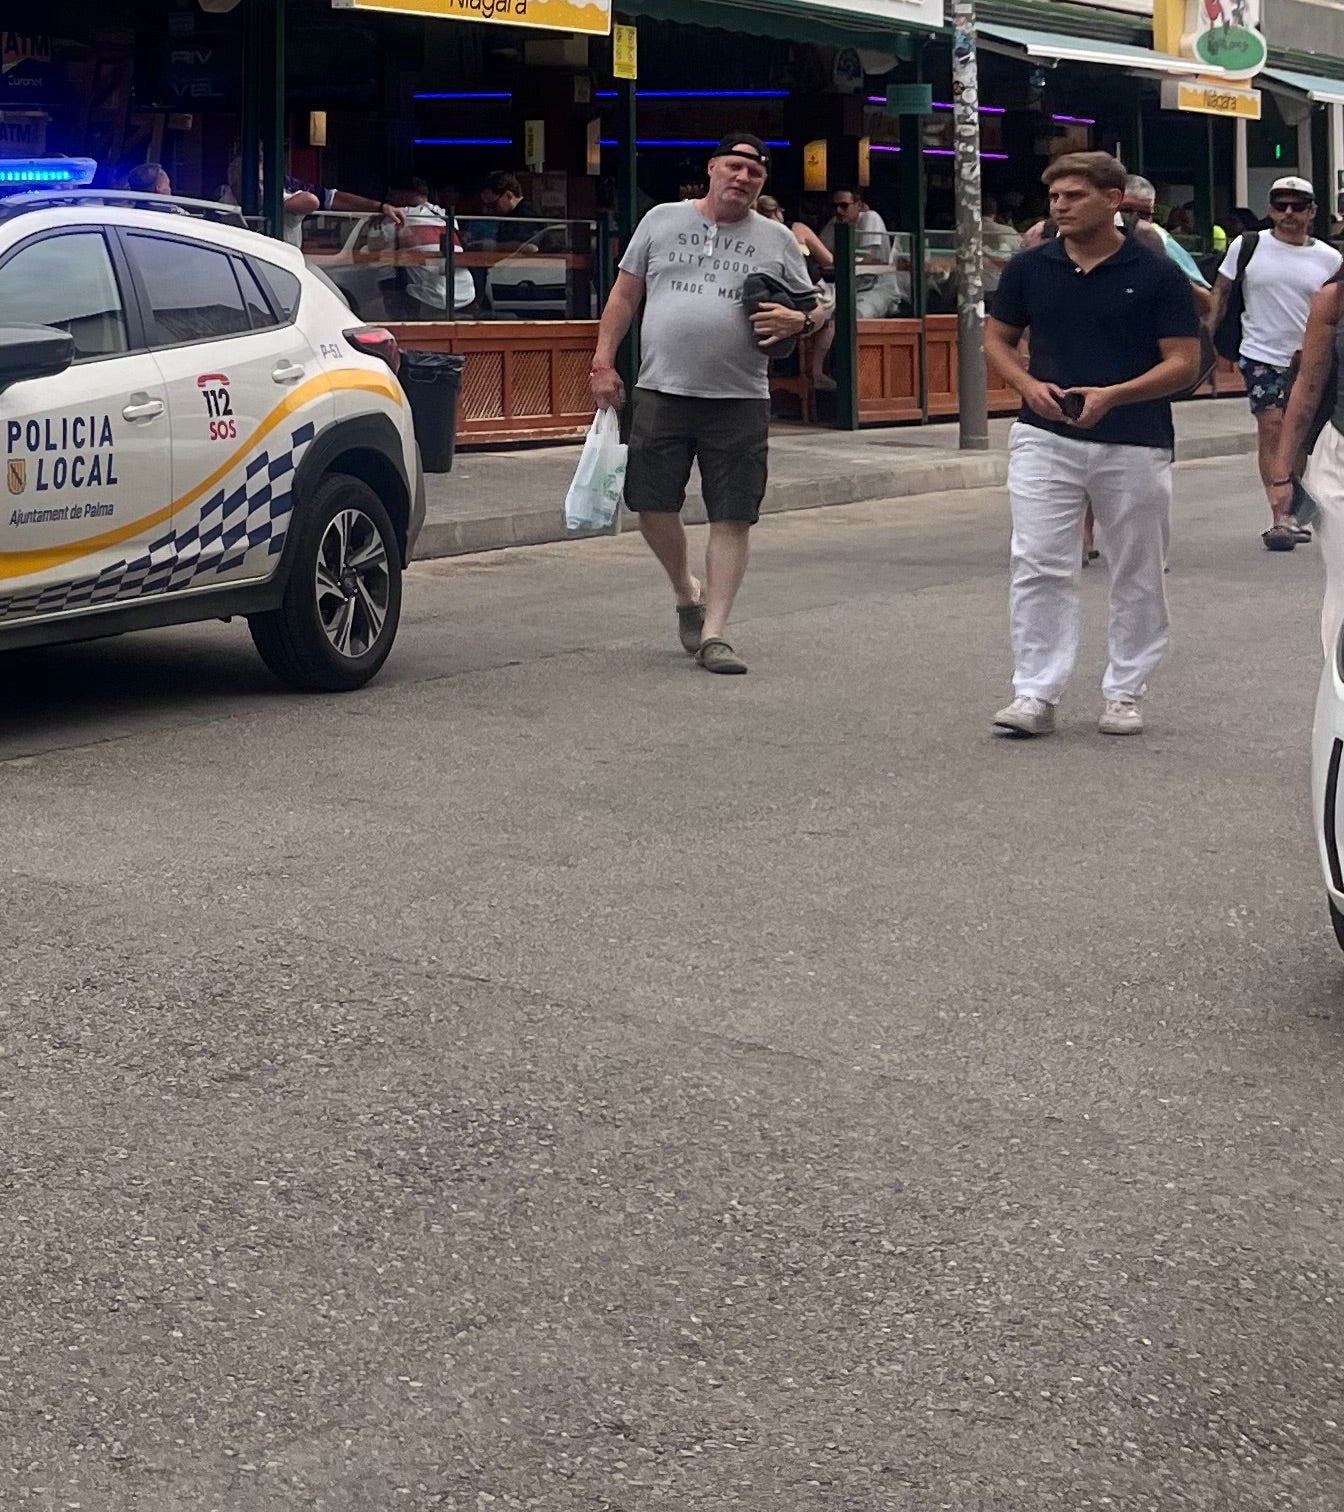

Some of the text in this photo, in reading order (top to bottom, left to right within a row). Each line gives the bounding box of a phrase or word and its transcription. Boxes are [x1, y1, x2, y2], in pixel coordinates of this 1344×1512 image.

[671, 280, 704, 294] TRADE
[202, 388, 234, 418] 112
[7, 414, 114, 454] POLICIA
[209, 419, 237, 440] SOS
[36, 453, 118, 491] LOCAL
[9, 501, 114, 528] Ajuntament de Palma
